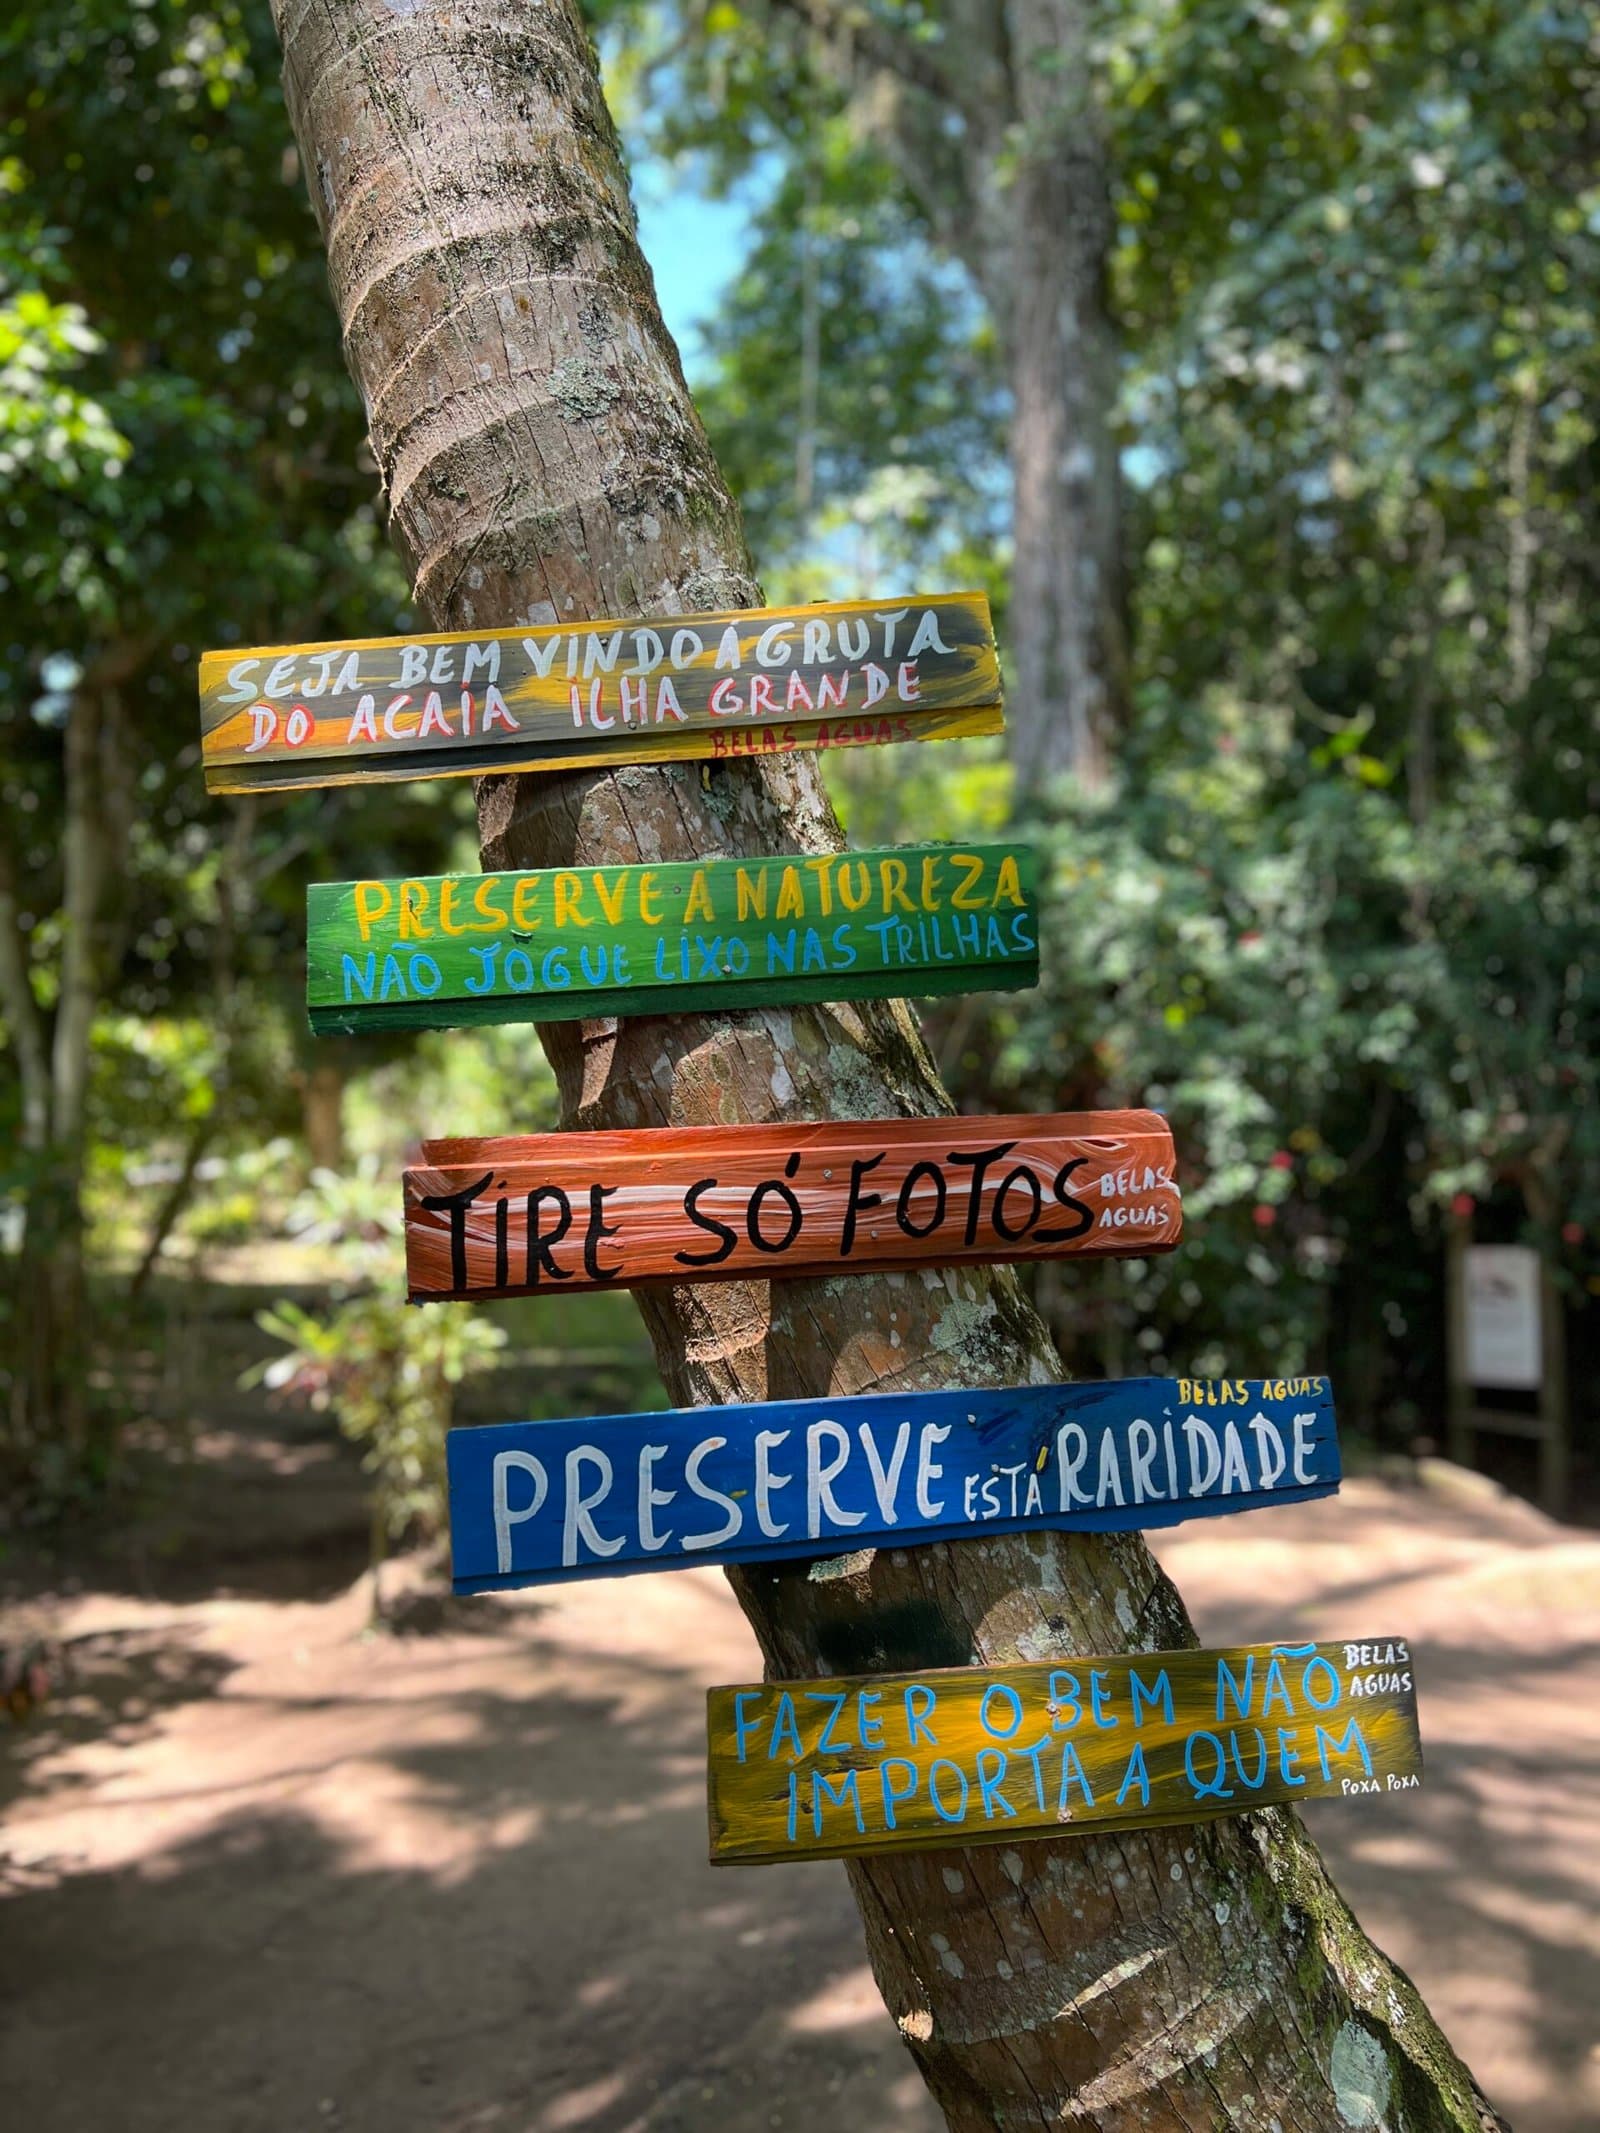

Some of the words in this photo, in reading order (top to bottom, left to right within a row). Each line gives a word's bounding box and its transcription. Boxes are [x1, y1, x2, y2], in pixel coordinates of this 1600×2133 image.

[217, 650, 363, 702] SEJA
[389, 639, 500, 688] BEM
[755, 608, 957, 667] GRUTA
[245, 701, 315, 753] DO
[347, 682, 520, 744] ACAIA
[568, 676, 689, 730] ILHA
[707, 658, 922, 718] GRANDE
[709, 726, 797, 758] BELAS
[816, 718, 912, 749] AGUAS
[354, 870, 664, 942] PRESERVE
[736, 853, 1028, 922] NATUREZA
[342, 943, 443, 1001] NÃO
[464, 942, 633, 994] JOGUE
[655, 929, 750, 980] LIXO
[767, 923, 858, 975] NAS
[865, 912, 1036, 965] TRILHAS
[421, 1171, 625, 1291] TIRE
[674, 1152, 802, 1266] SÓ
[840, 1142, 1094, 1256] FOTOS
[1099, 1203, 1169, 1228] AGUAS
[1100, 1166, 1169, 1197] BELAS
[1176, 1377, 1249, 1406] BELAS
[1262, 1375, 1324, 1402] AGUAS
[493, 1420, 952, 1573] PRESERVE
[1057, 1407, 1319, 1512] RARIDADE
[1343, 1642, 1409, 1670] BELAS
[1350, 1672, 1412, 1697] AGUAS
[735, 1685, 937, 1764] FAZER
[979, 1684, 1023, 1740] O
[1050, 1668, 1175, 1732] BEM
[1216, 1642, 1341, 1721] NÃO
[787, 1733, 1095, 1842] IMPORTA
[1116, 1742, 1150, 1807] A
[1184, 1716, 1373, 1799] QUEM
[1341, 1778, 1381, 1796] POXA
